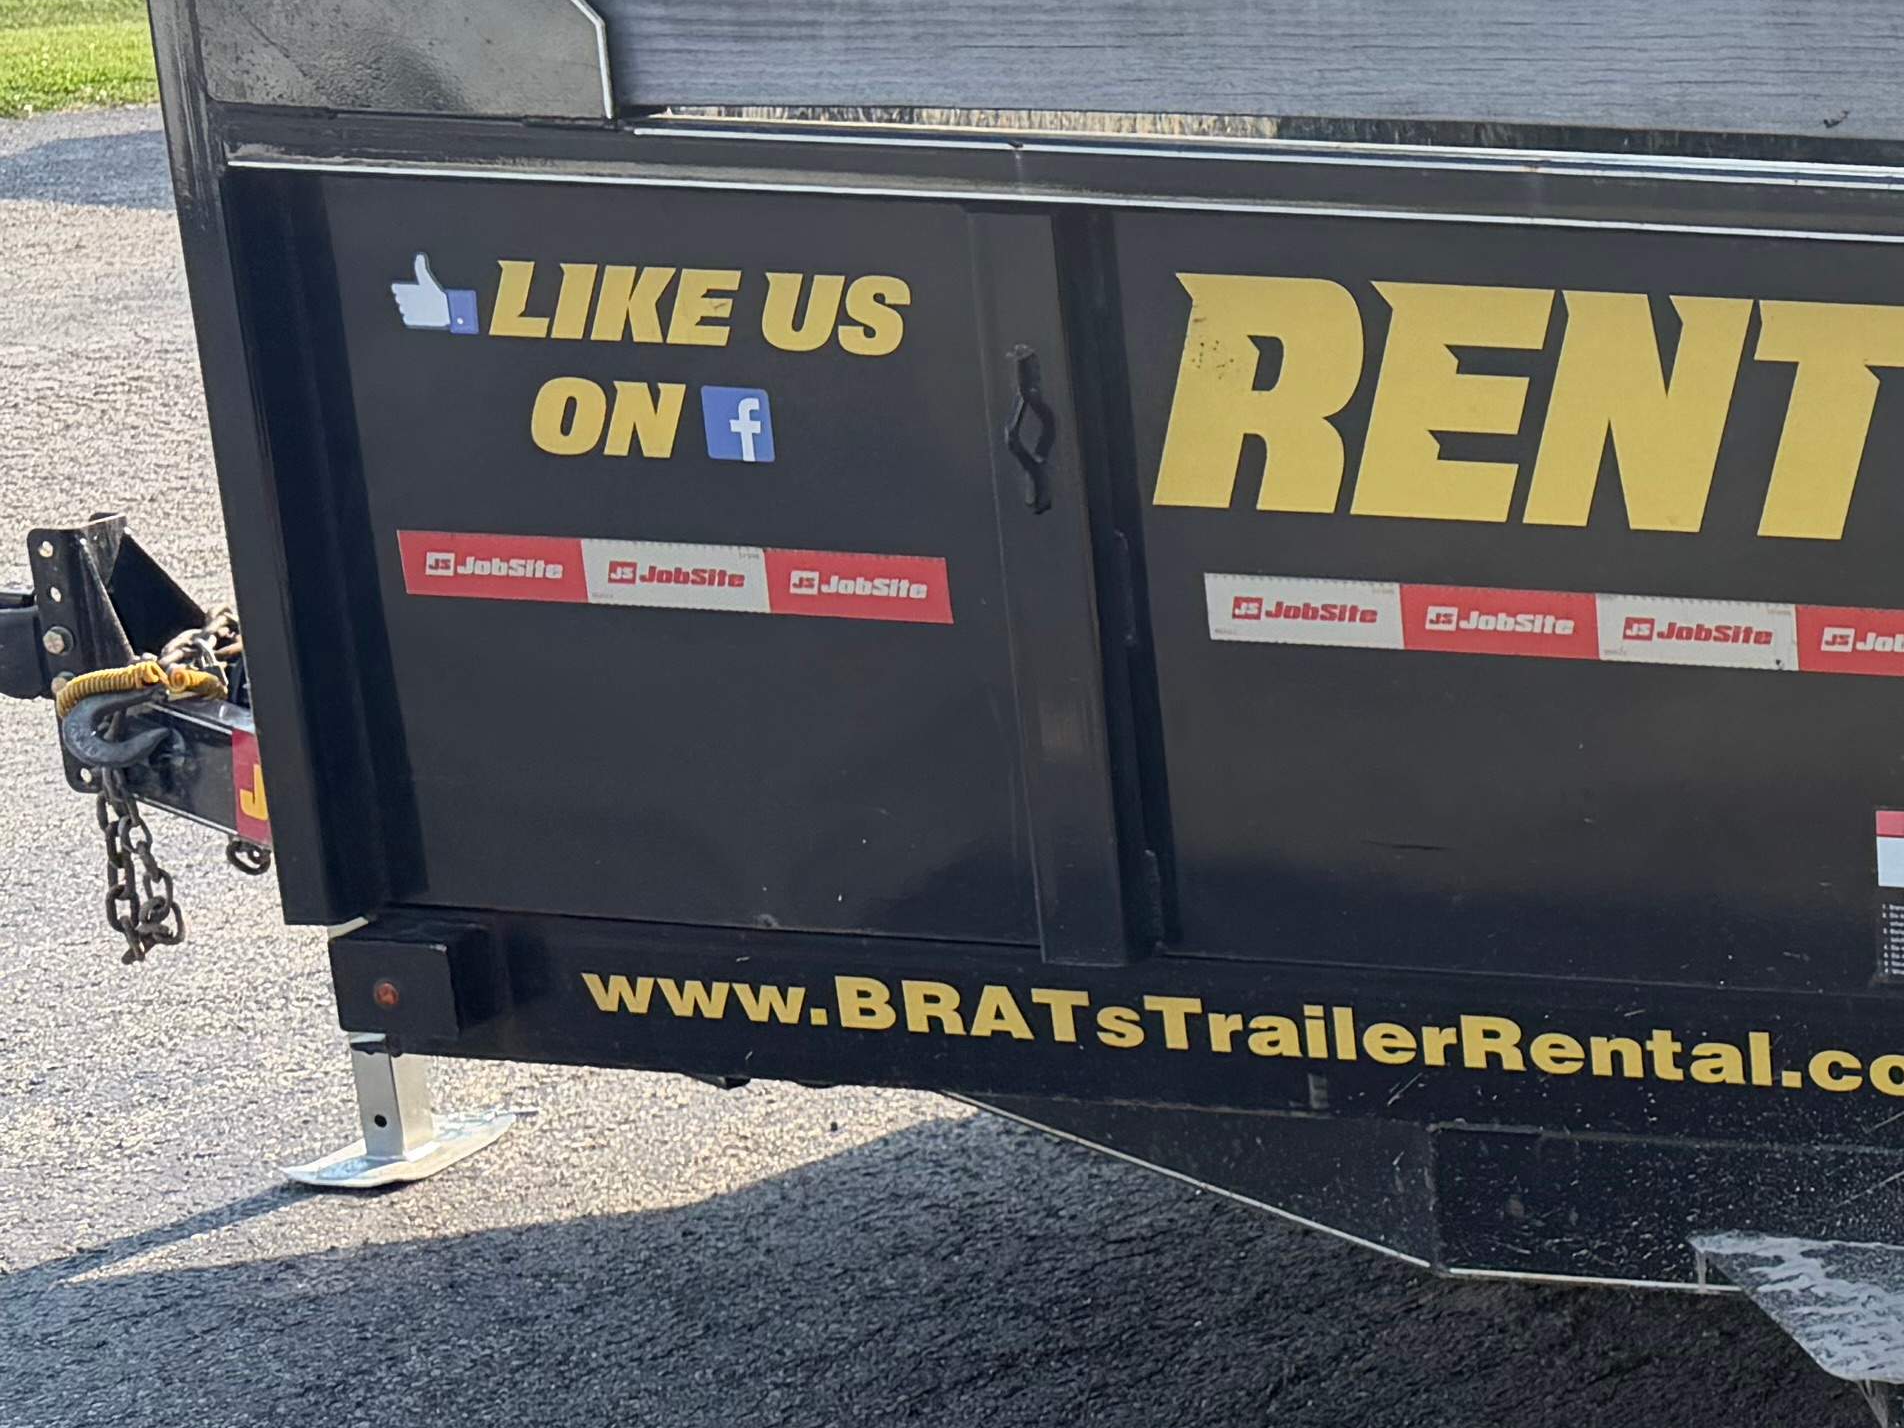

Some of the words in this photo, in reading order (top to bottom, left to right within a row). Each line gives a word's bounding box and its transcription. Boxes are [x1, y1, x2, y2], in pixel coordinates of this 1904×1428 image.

[488, 259, 742, 347] LIKE
[760, 272, 911, 356] US
[530, 376, 687, 459] ON
[457, 556, 563, 579] JobSite
[640, 565, 745, 588] JobSite
[822, 575, 928, 599] JobSite
[1265, 601, 1377, 623] JobSite
[1460, 611, 1575, 635] JobSite
[1657, 622, 1773, 644] JobSite
